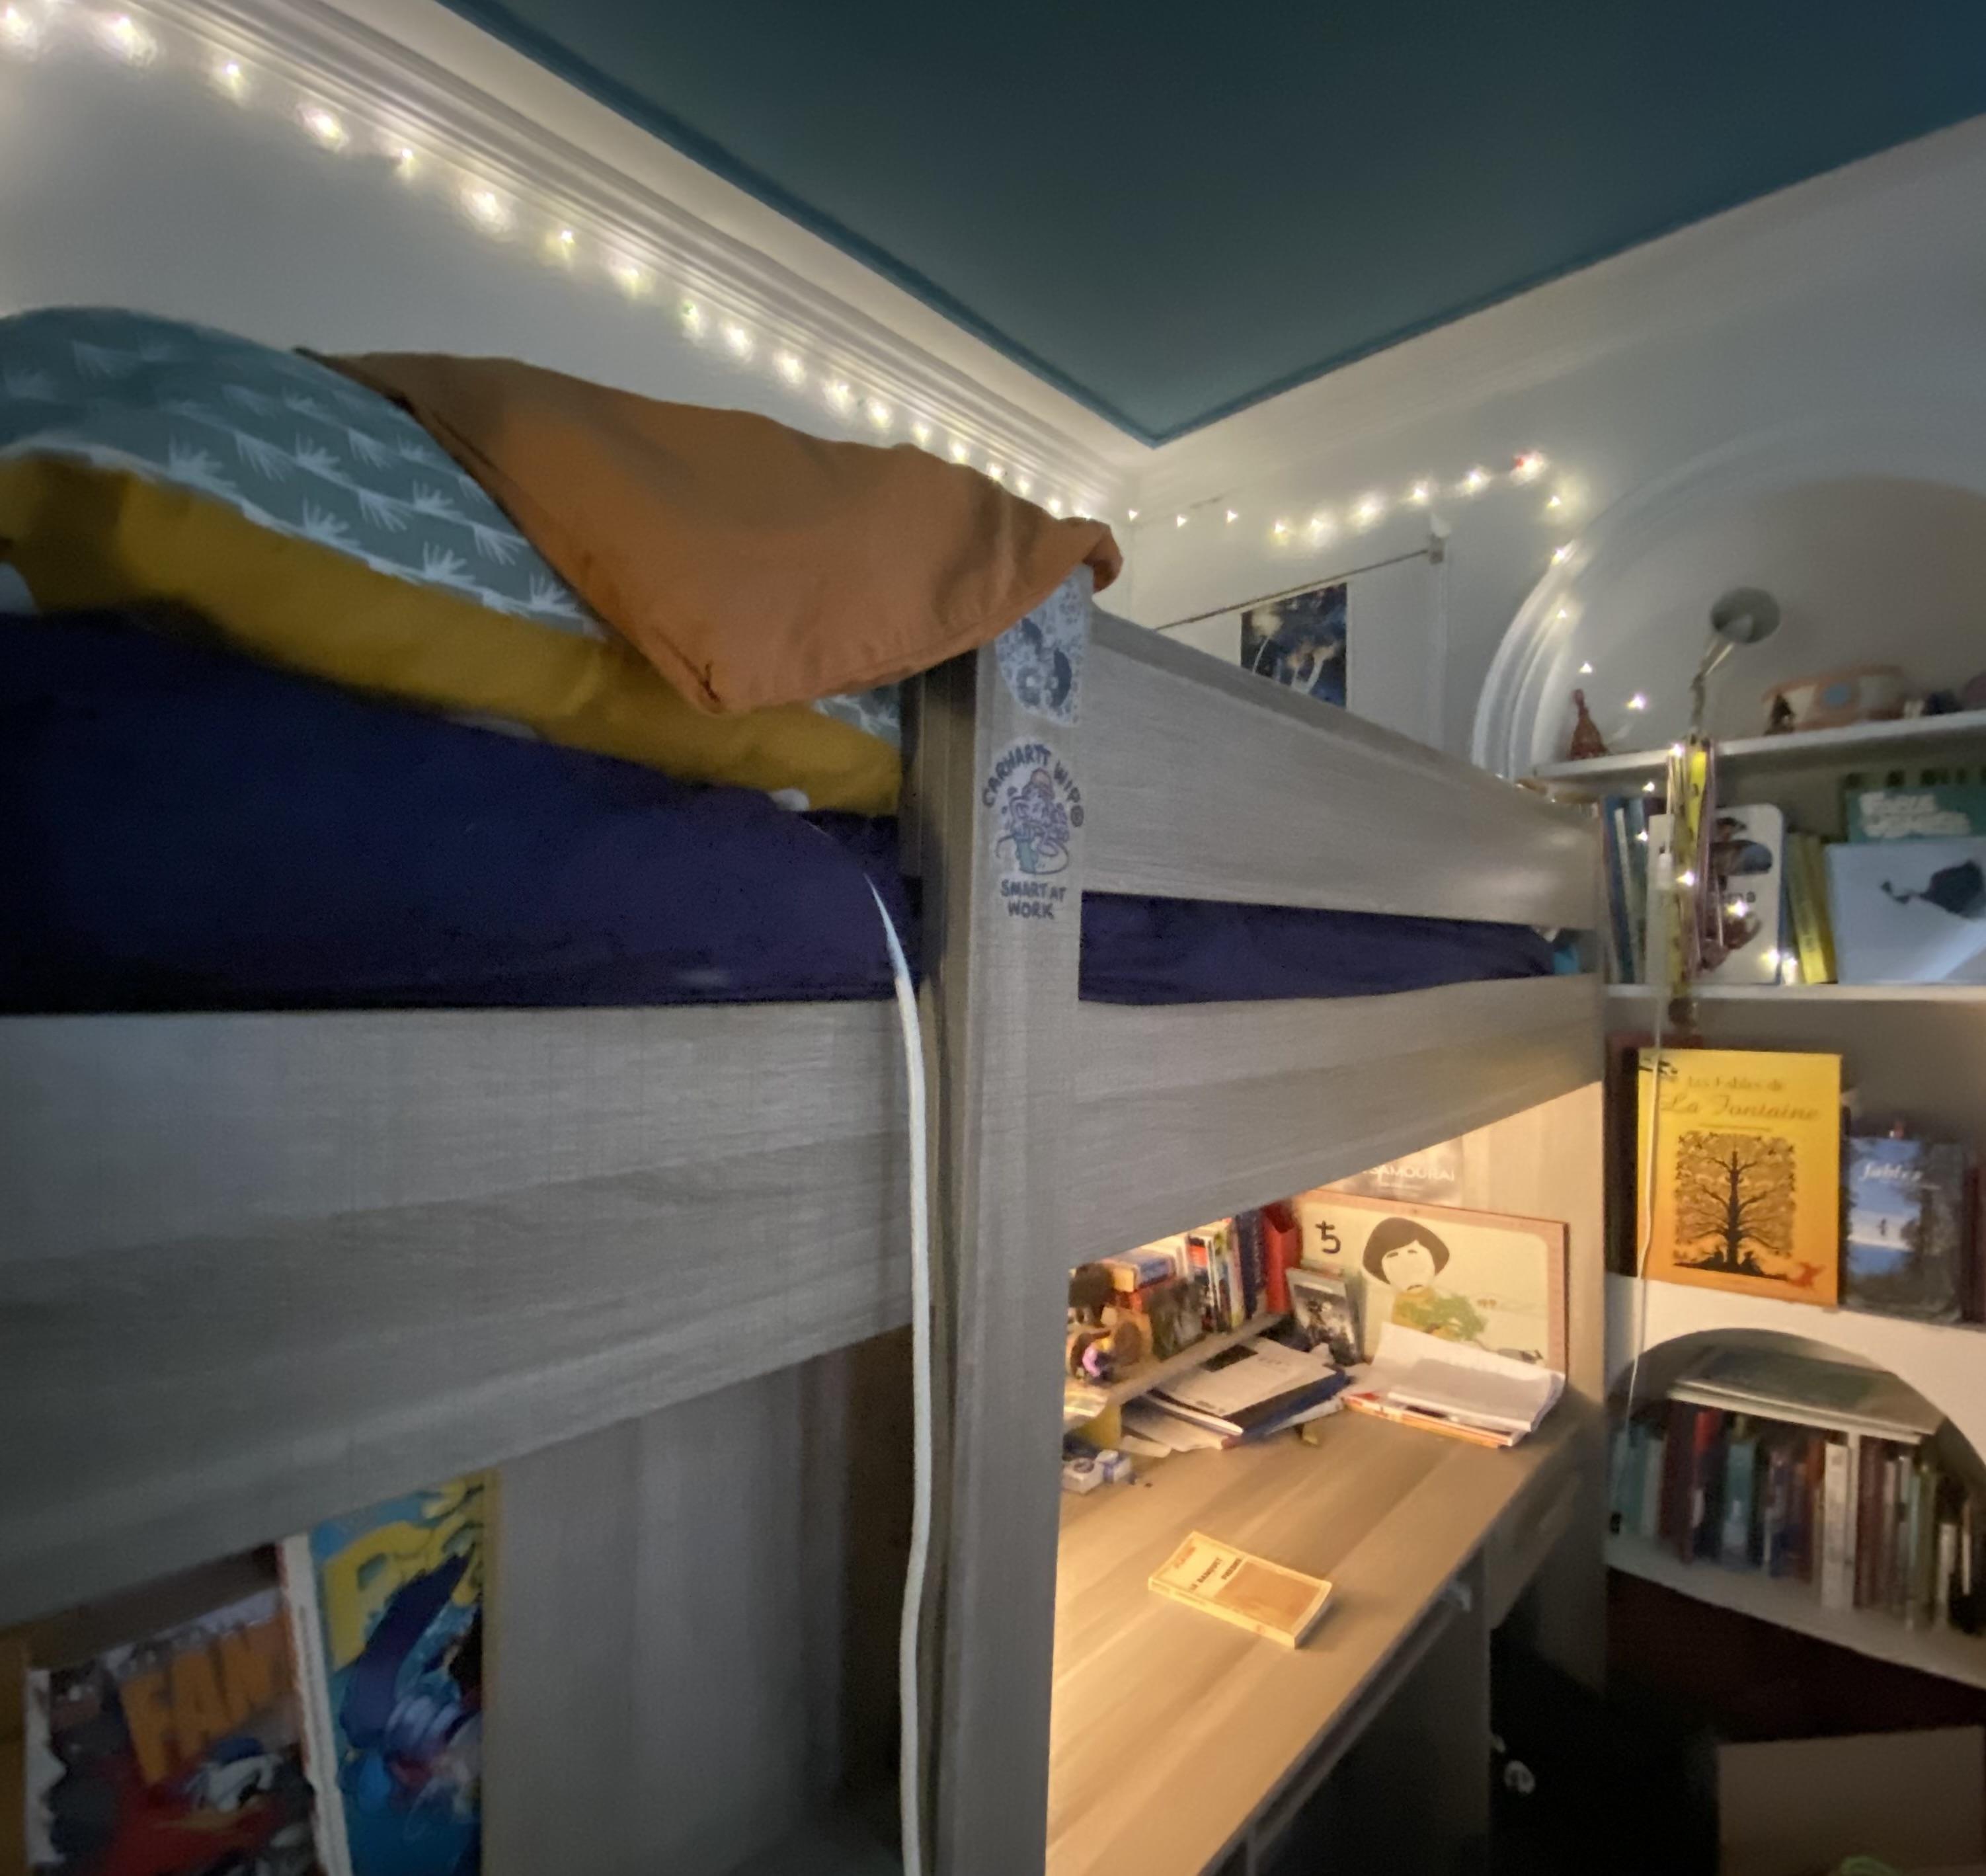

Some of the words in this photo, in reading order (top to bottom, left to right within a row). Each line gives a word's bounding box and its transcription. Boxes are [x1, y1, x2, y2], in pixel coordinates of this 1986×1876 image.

[982, 744, 1051, 808] CARHARTT
[1000, 878, 1048, 898] SMART
[1050, 886, 1067, 902] AT
[1007, 900, 1054, 919] WORK
[1712, 1093, 1819, 1120] Fontaine
